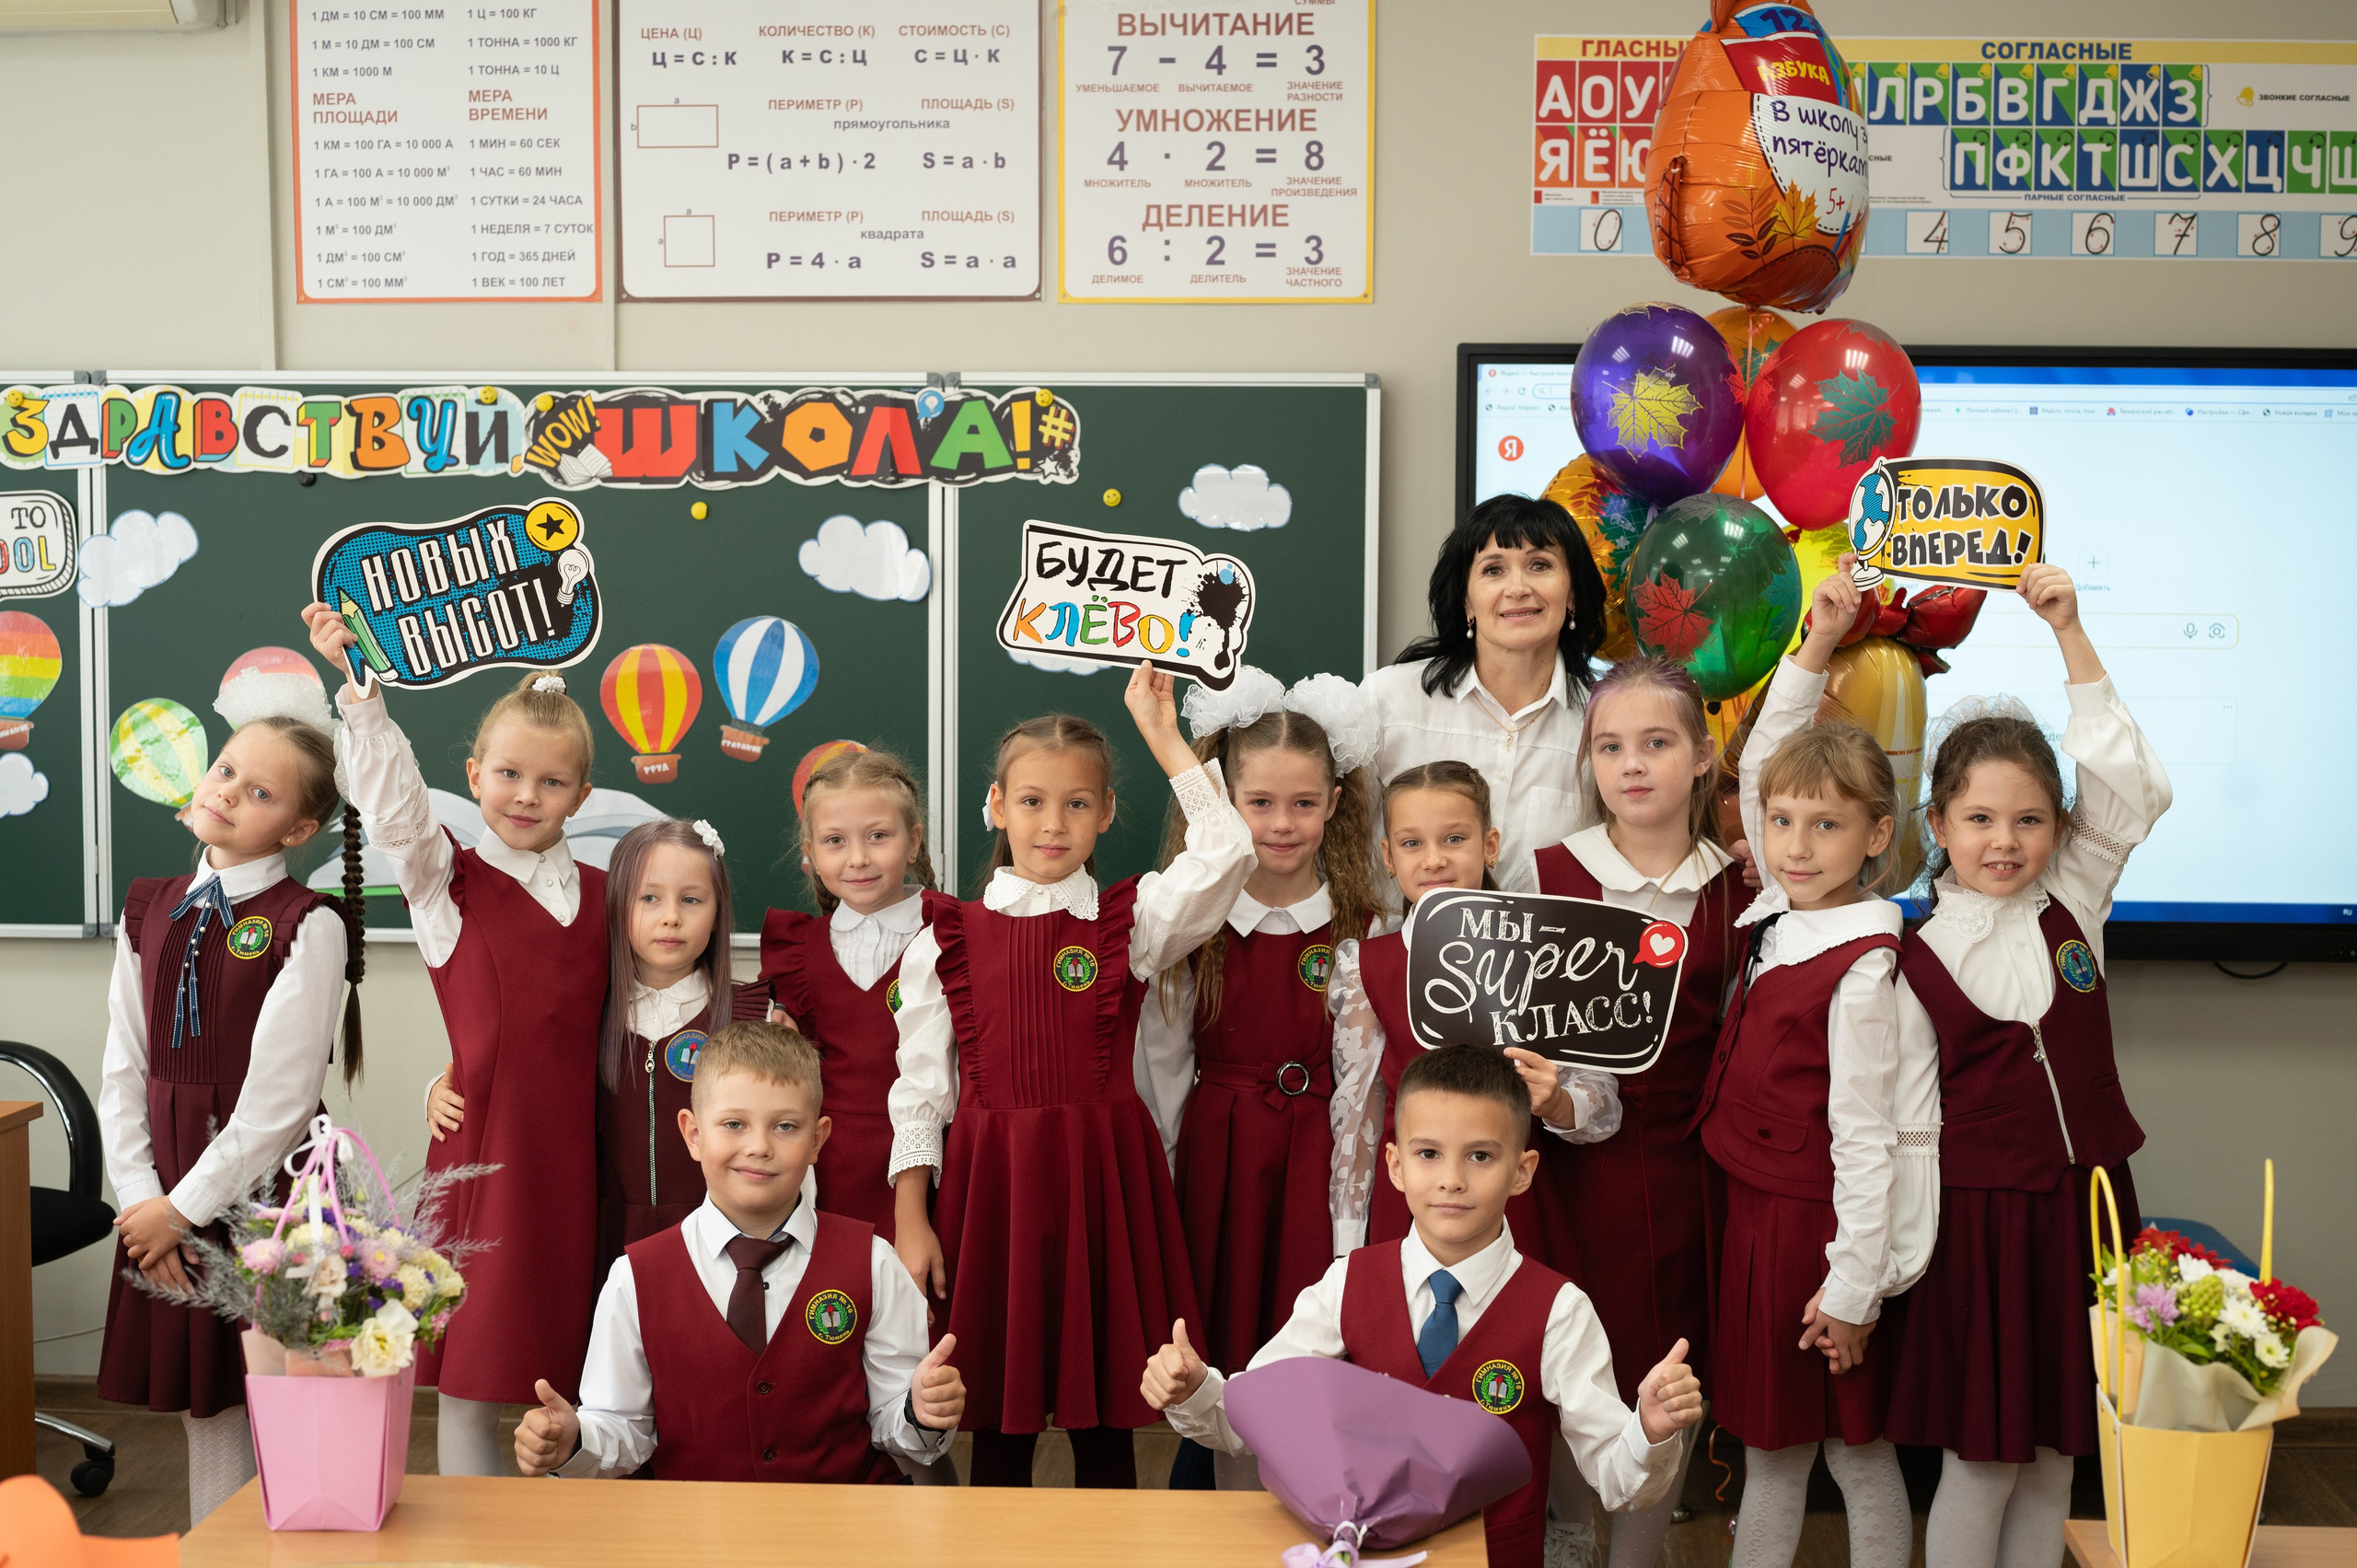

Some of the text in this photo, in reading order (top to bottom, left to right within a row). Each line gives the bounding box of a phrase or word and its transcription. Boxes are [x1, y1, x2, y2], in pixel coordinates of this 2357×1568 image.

[760, 26, 853, 36] КОЛИЧЕСТВО
[900, 25, 986, 36] СТОИМОСТЬ
[1119, 13, 1314, 36] ВЫЧИТАНИЕ
[642, 29, 702, 41] ЦЕНА (Ц)
[1581, 40, 1684, 57] ГЛАСНЫ
[1981, 42, 2131, 60] СОГЛАСНЫЕ
[1108, 46, 1127, 75] 7
[1205, 45, 1226, 75] 4
[1306, 45, 1325, 75] 3
[1756, 60, 1830, 86] АЗБУКА
[1076, 84, 1158, 92] УМЕНЬШАЕМОЕ
[1178, 84, 1252, 92] ВЫЧИТАЕМОЕ
[1288, 81, 1341, 89] ЗНАЧЕНИЕ
[313, 93, 356, 105] МЕРА
[470, 90, 512, 102] МЕРА
[1288, 93, 1342, 101] РАЗНОСТИ
[769, 99, 841, 110] ПЕРИМЕТР
[922, 99, 993, 110] ПЛОЩАДЬ
[314, 110, 397, 125] ПЛОЩАДИ
[470, 108, 547, 121] ВРЕМЕНИ
[1116, 109, 1317, 132] УМНОЖЕНИЕ
[834, 120, 949, 131] прямоугольника
[1772, 100, 1790, 122] В
[1798, 107, 1859, 152] школу
[470, 140, 474, 148] 1
[480, 139, 505, 147] МИН
[520, 139, 532, 147] 60
[537, 139, 560, 147] СЕК
[1108, 141, 1128, 171] 4
[1206, 141, 1225, 170] 2
[1305, 141, 1324, 170] 8
[1772, 135, 1868, 177] пятёркам
[470, 168, 474, 176] 1
[481, 168, 504, 176] ЧАС
[519, 167, 531, 176] 60
[536, 167, 561, 176] МИН
[1287, 177, 1341, 185] ЗНАЧЕНИЕ
[1271, 189, 1356, 197] ПРОИЗВЕДЕНИЯ
[471, 197, 475, 205] 1
[481, 196, 518, 205] СУТКИ
[533, 196, 545, 204] 24
[550, 196, 582, 204] ЧАСА
[1826, 187, 1846, 215] 5+
[770, 212, 842, 221] ПЕРИМЕТР
[923, 211, 993, 222] ПЛОЩАДЬ
[1143, 204, 1289, 231] ДЕЛЕНИЕ
[472, 225, 475, 233] 1
[482, 225, 529, 235] НЕДЕЛЯ
[545, 225, 550, 233] 7
[554, 224, 592, 233] СУТОК
[861, 230, 923, 241] квадрата
[1923, 212, 1948, 253] 4
[1999, 214, 2031, 253] 5
[2085, 214, 2114, 254] 6
[2169, 214, 2198, 254] 7
[2252, 214, 2280, 255] 8
[472, 252, 476, 261] 1
[482, 252, 505, 262] ГОД
[520, 252, 539, 261] 365
[542, 250, 575, 261] ДНЕЙ
[1109, 236, 1127, 265] 6
[1206, 236, 1225, 265] 2
[1305, 235, 1323, 265] 3
[1287, 267, 1341, 275] ЗНАЧЕНИЕ
[472, 278, 476, 286] 1
[482, 278, 505, 286] ВЕК
[520, 278, 539, 286] 100
[542, 277, 564, 286] ЛЕТ
[1092, 275, 1143, 284] ДЕЛИМОЕ
[1190, 274, 1246, 284] ДЕЛИТЕЛЬ
[594, 400, 1031, 478] ШКОЛА!
[1504, 439, 1518, 457] Я
[1897, 485, 2027, 522] ТОЛЬКО
[11, 506, 46, 529] TO
[1892, 528, 2032, 565] ВПЕРЕД!
[361, 519, 518, 612] НОВЫХ
[1036, 541, 1188, 598] БУДЕТ
[2074, 583, 2112, 592] Добавить
[398, 578, 555, 677] ВЫСОТ!
[1013, 595, 1196, 657] КЛЁВО!
[2342, 908, 2353, 916] RU
[1424, 936, 1638, 1023] Super
[1489, 991, 1654, 1046] КЛАСС!
[809, 1294, 837, 1319] ГИМНАЗИЯ
[825, 1330, 850, 1341] Тюмень
[1476, 1363, 1512, 1383] ГИМНАЗИЯ
[1485, 1401, 1511, 1411] Тюмень
